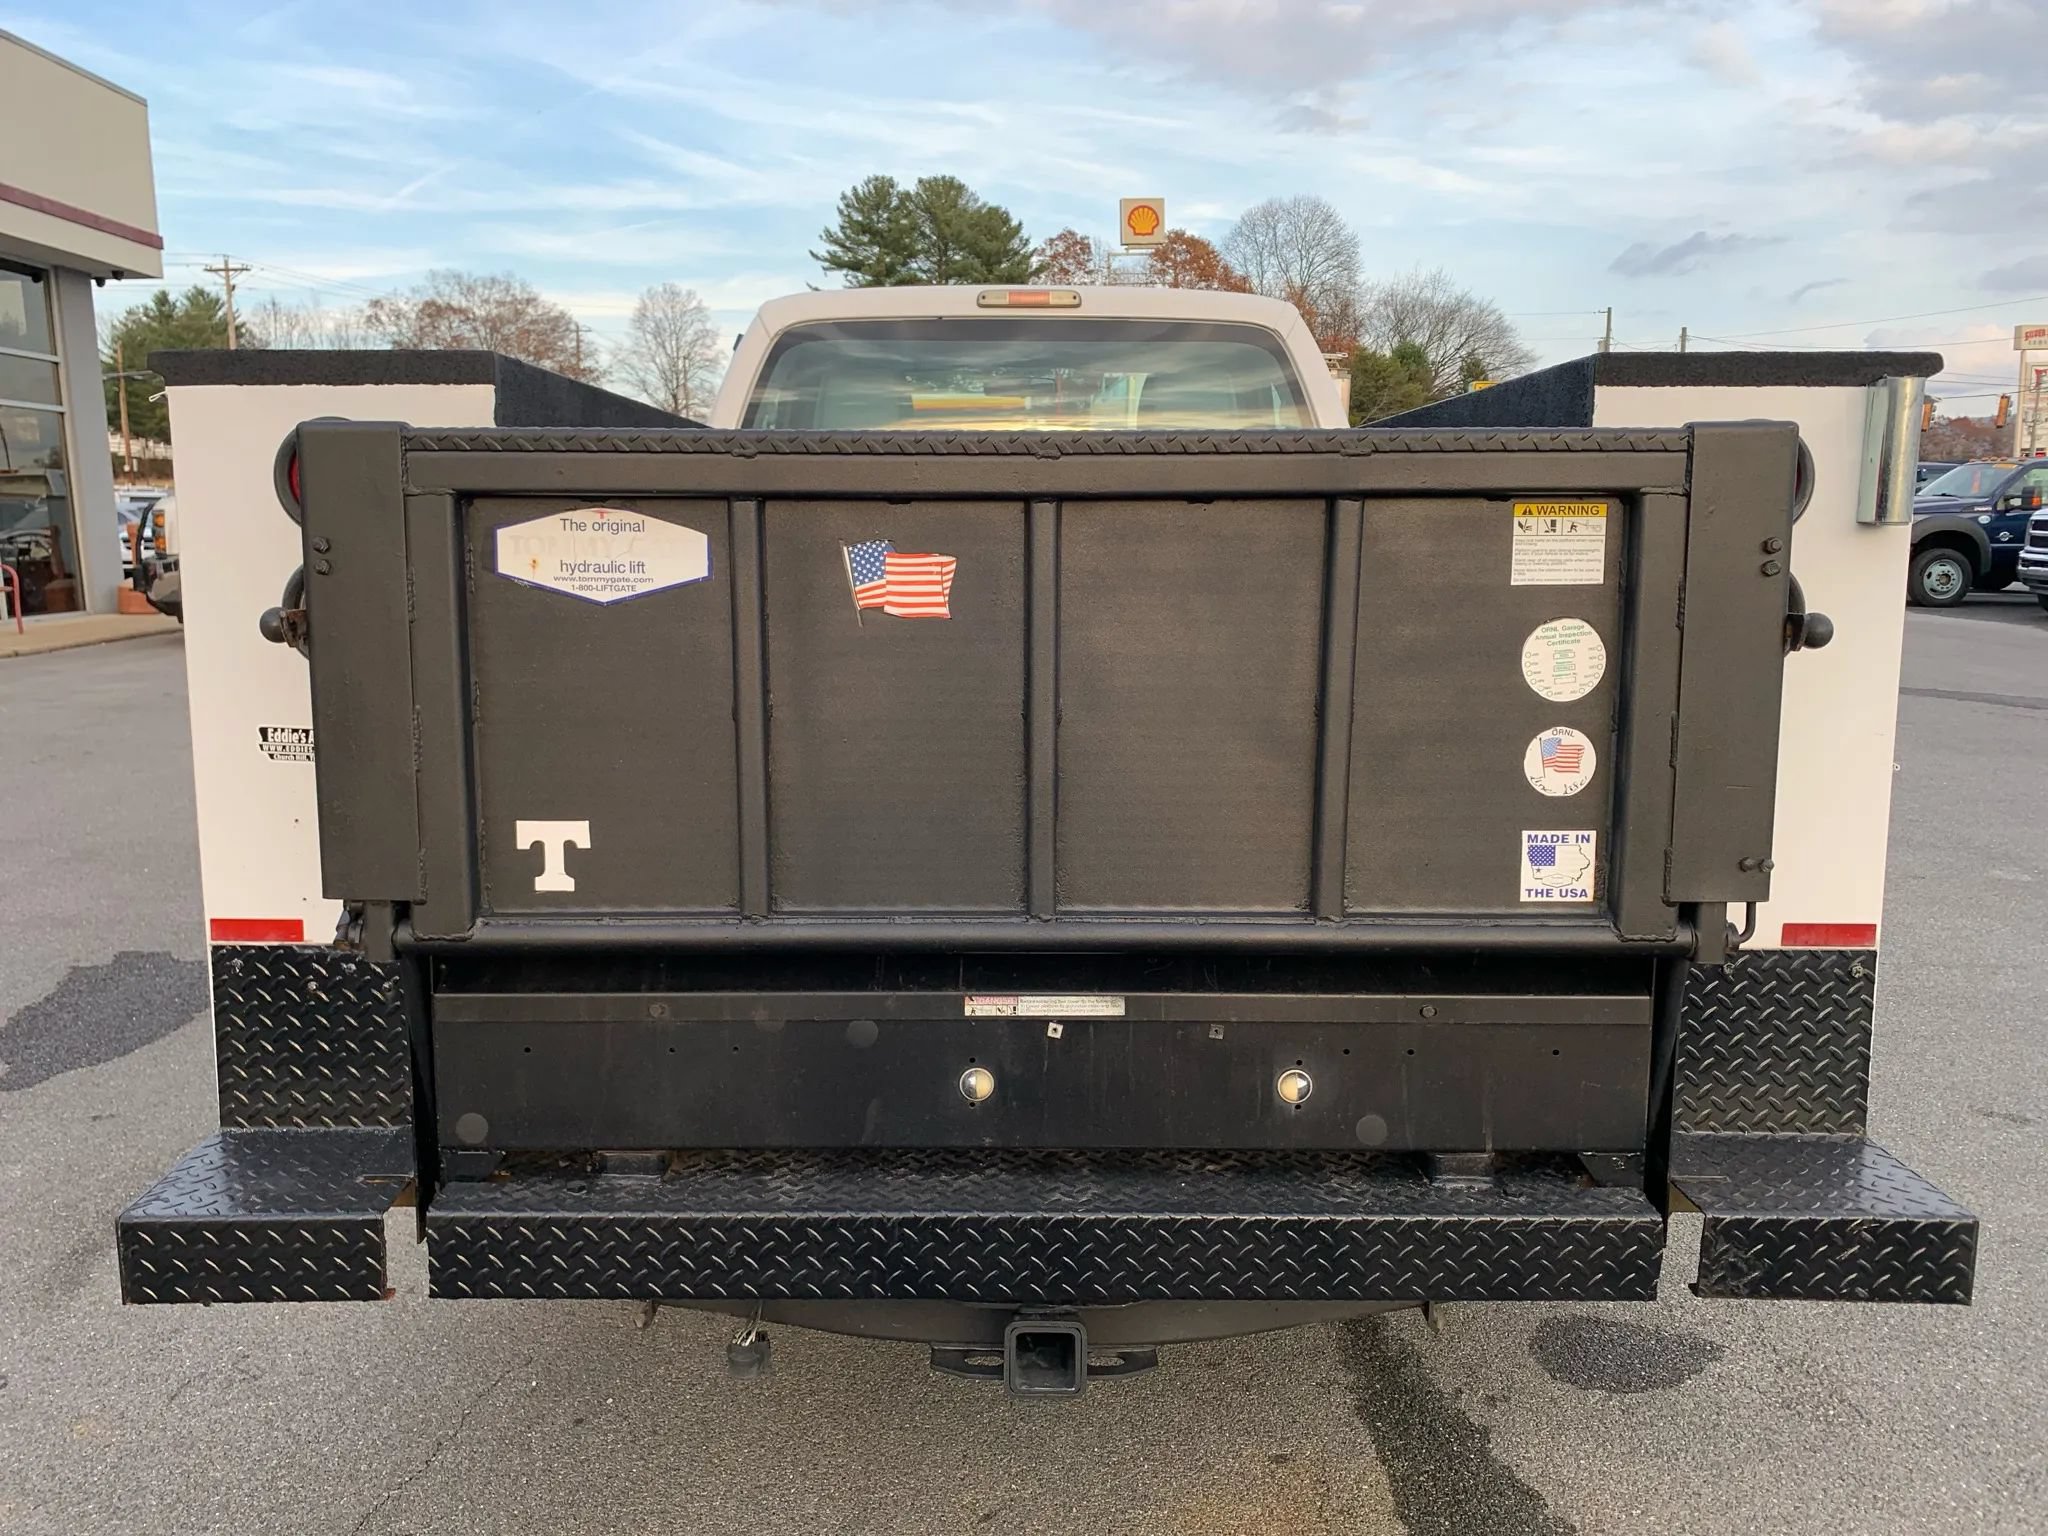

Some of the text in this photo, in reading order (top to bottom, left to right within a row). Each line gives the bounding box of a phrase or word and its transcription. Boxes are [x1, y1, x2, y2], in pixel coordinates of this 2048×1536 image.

[1536, 505, 1600, 515] WARNING
[560, 518, 645, 535] The original
[560, 559, 646, 577] hydraulic lift
[553, 575, 654, 585] www.tommygate.com
[571, 584, 637, 592] 1-800-LIFTGATE
[1562, 624, 1585, 632] Garage
[1535, 630, 1593, 641] Annual Inspection
[1546, 638, 1581, 647] Certificate
[267, 727, 307, 743] Eddie's
[1551, 727, 1575, 738] ORNL
[1527, 834, 1591, 843] MADE IN
[516, 820, 591, 891] T
[1525, 888, 1589, 898] THE USA
